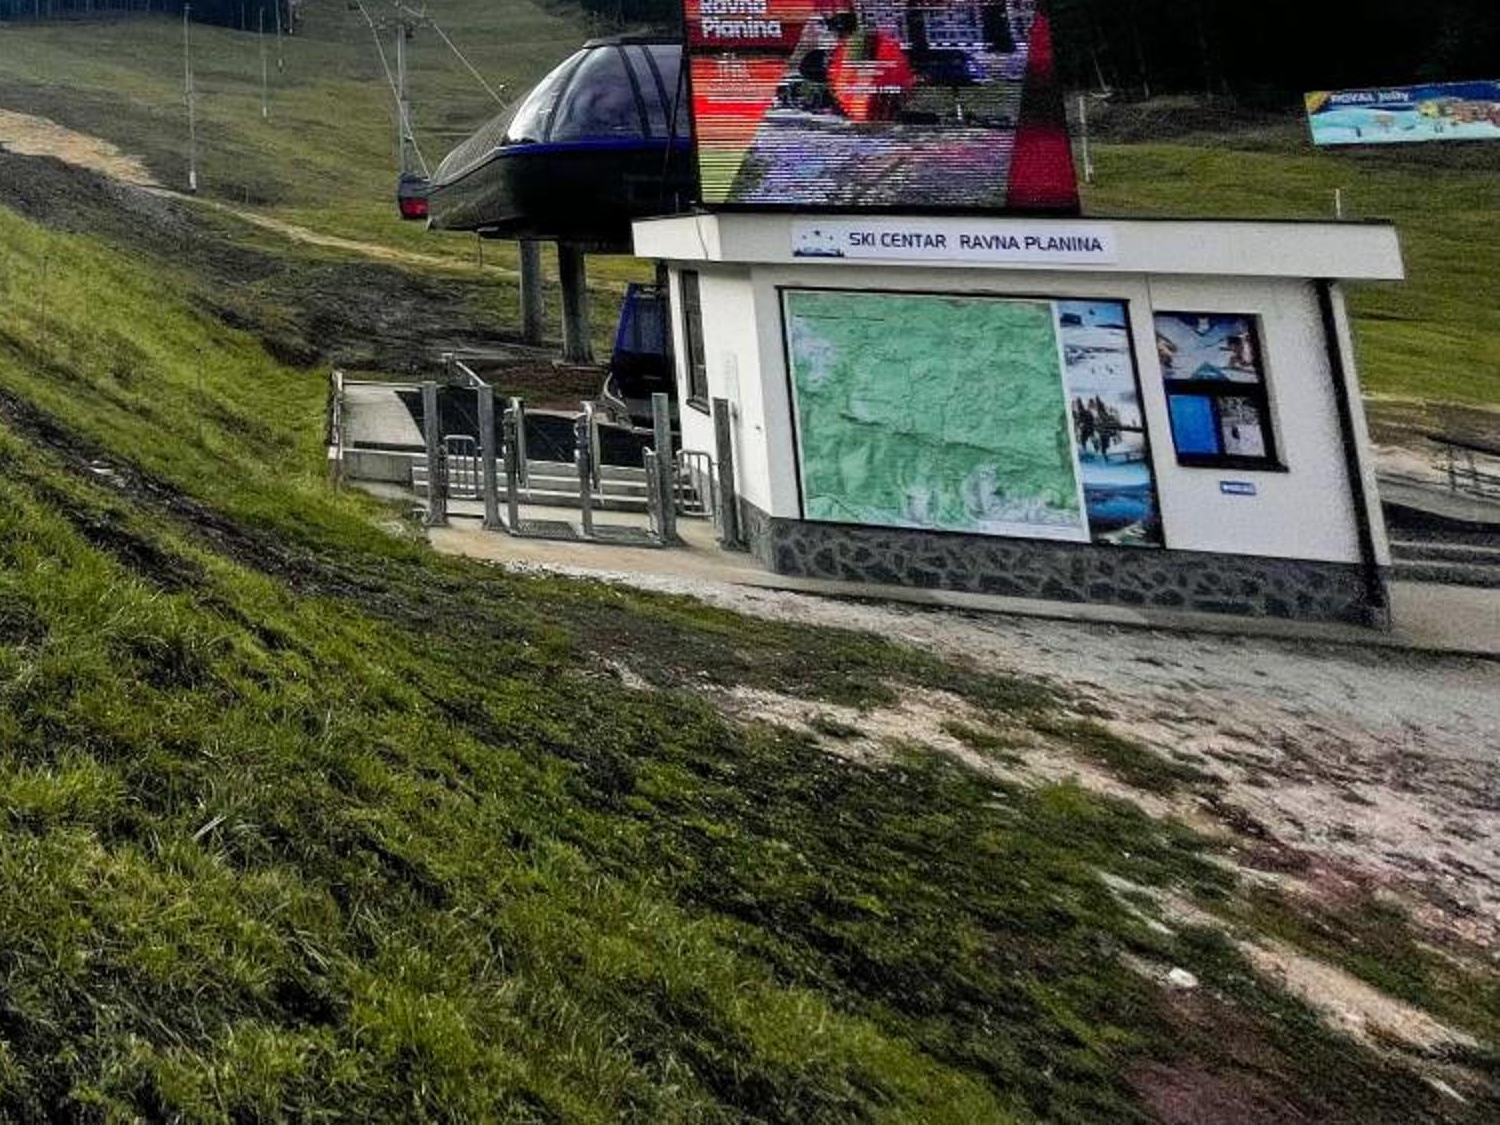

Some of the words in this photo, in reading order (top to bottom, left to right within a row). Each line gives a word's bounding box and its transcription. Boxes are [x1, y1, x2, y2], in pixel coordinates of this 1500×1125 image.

[701, 16, 782, 38] Planina
[849, 232, 875, 246] SKI
[881, 232, 947, 249] CENTAR
[959, 234, 1020, 250] RAVNA
[1024, 236, 1103, 252] PLANINA
